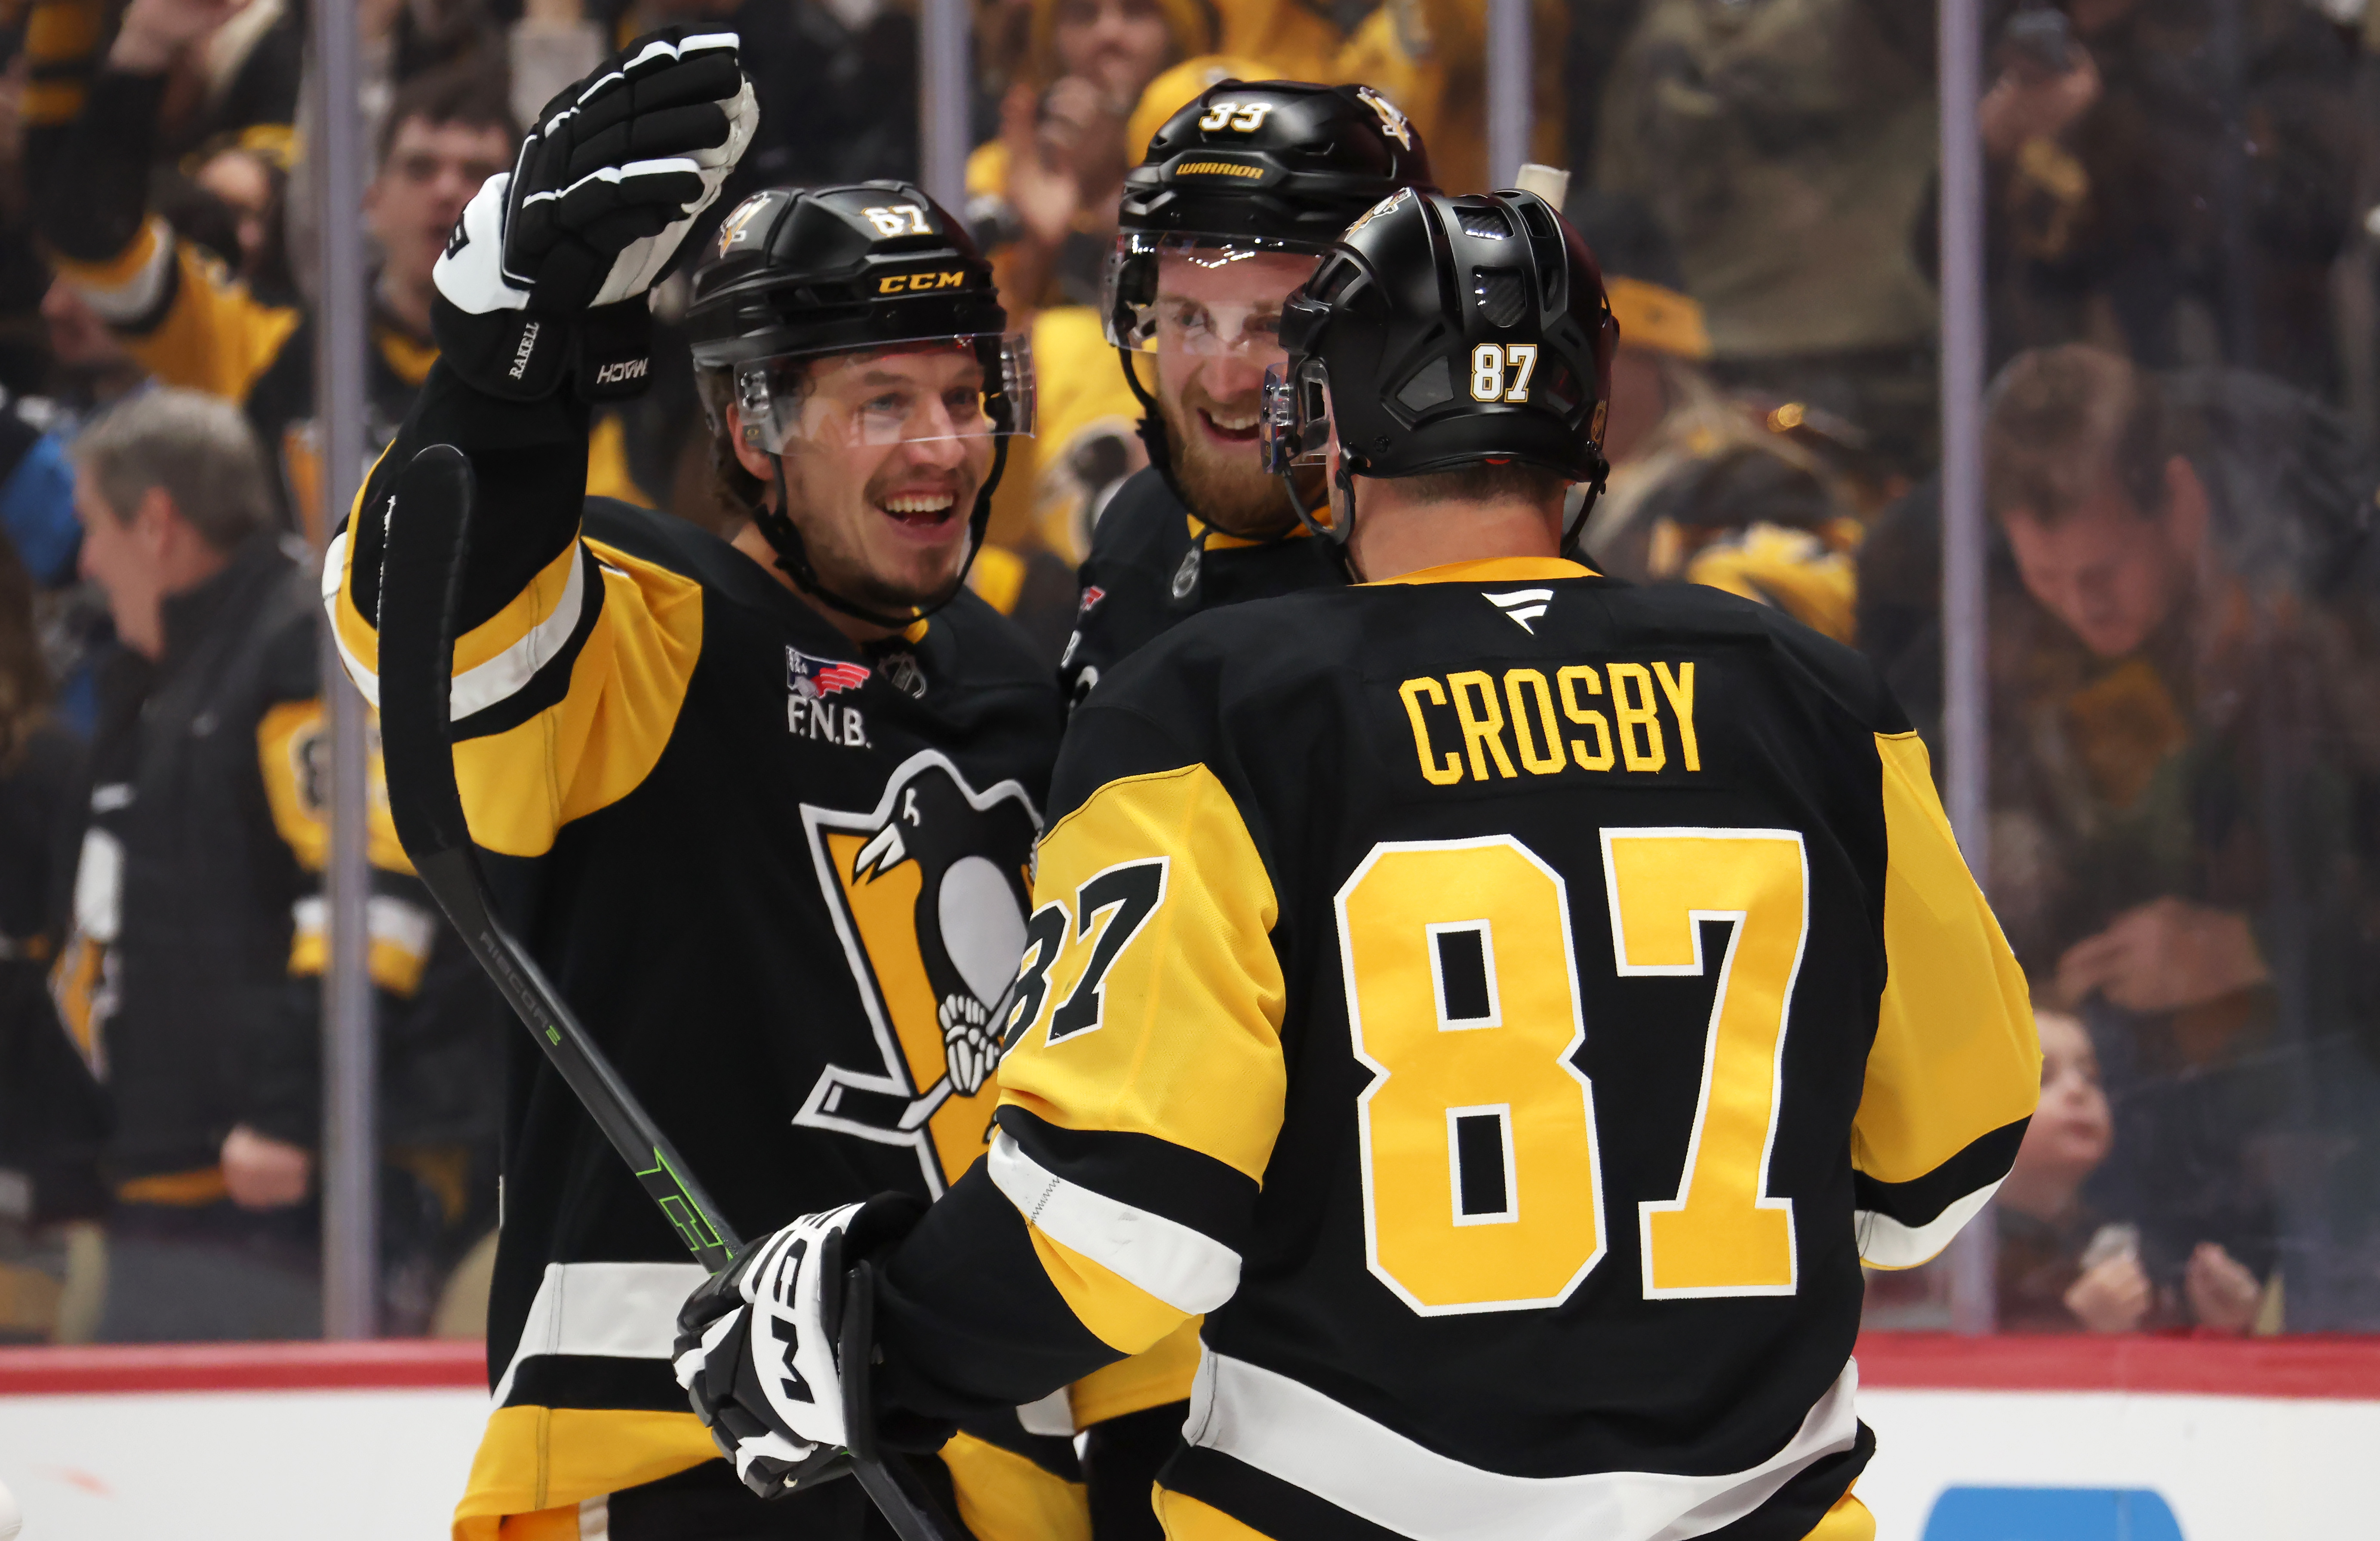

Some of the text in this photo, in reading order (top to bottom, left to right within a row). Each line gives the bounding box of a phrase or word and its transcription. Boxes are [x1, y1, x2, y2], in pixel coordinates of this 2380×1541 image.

[1175, 162, 1264, 179] WARRIOR
[861, 204, 933, 237] 67
[878, 271, 965, 294] CCM
[508, 322, 540, 380] RAKELL
[1470, 343, 1537, 402] 87
[787, 693, 872, 749] F.N.B.
[1399, 661, 1700, 785] CROSBY
[998, 855, 1170, 1074] 87
[1334, 826, 1809, 1317] 87
